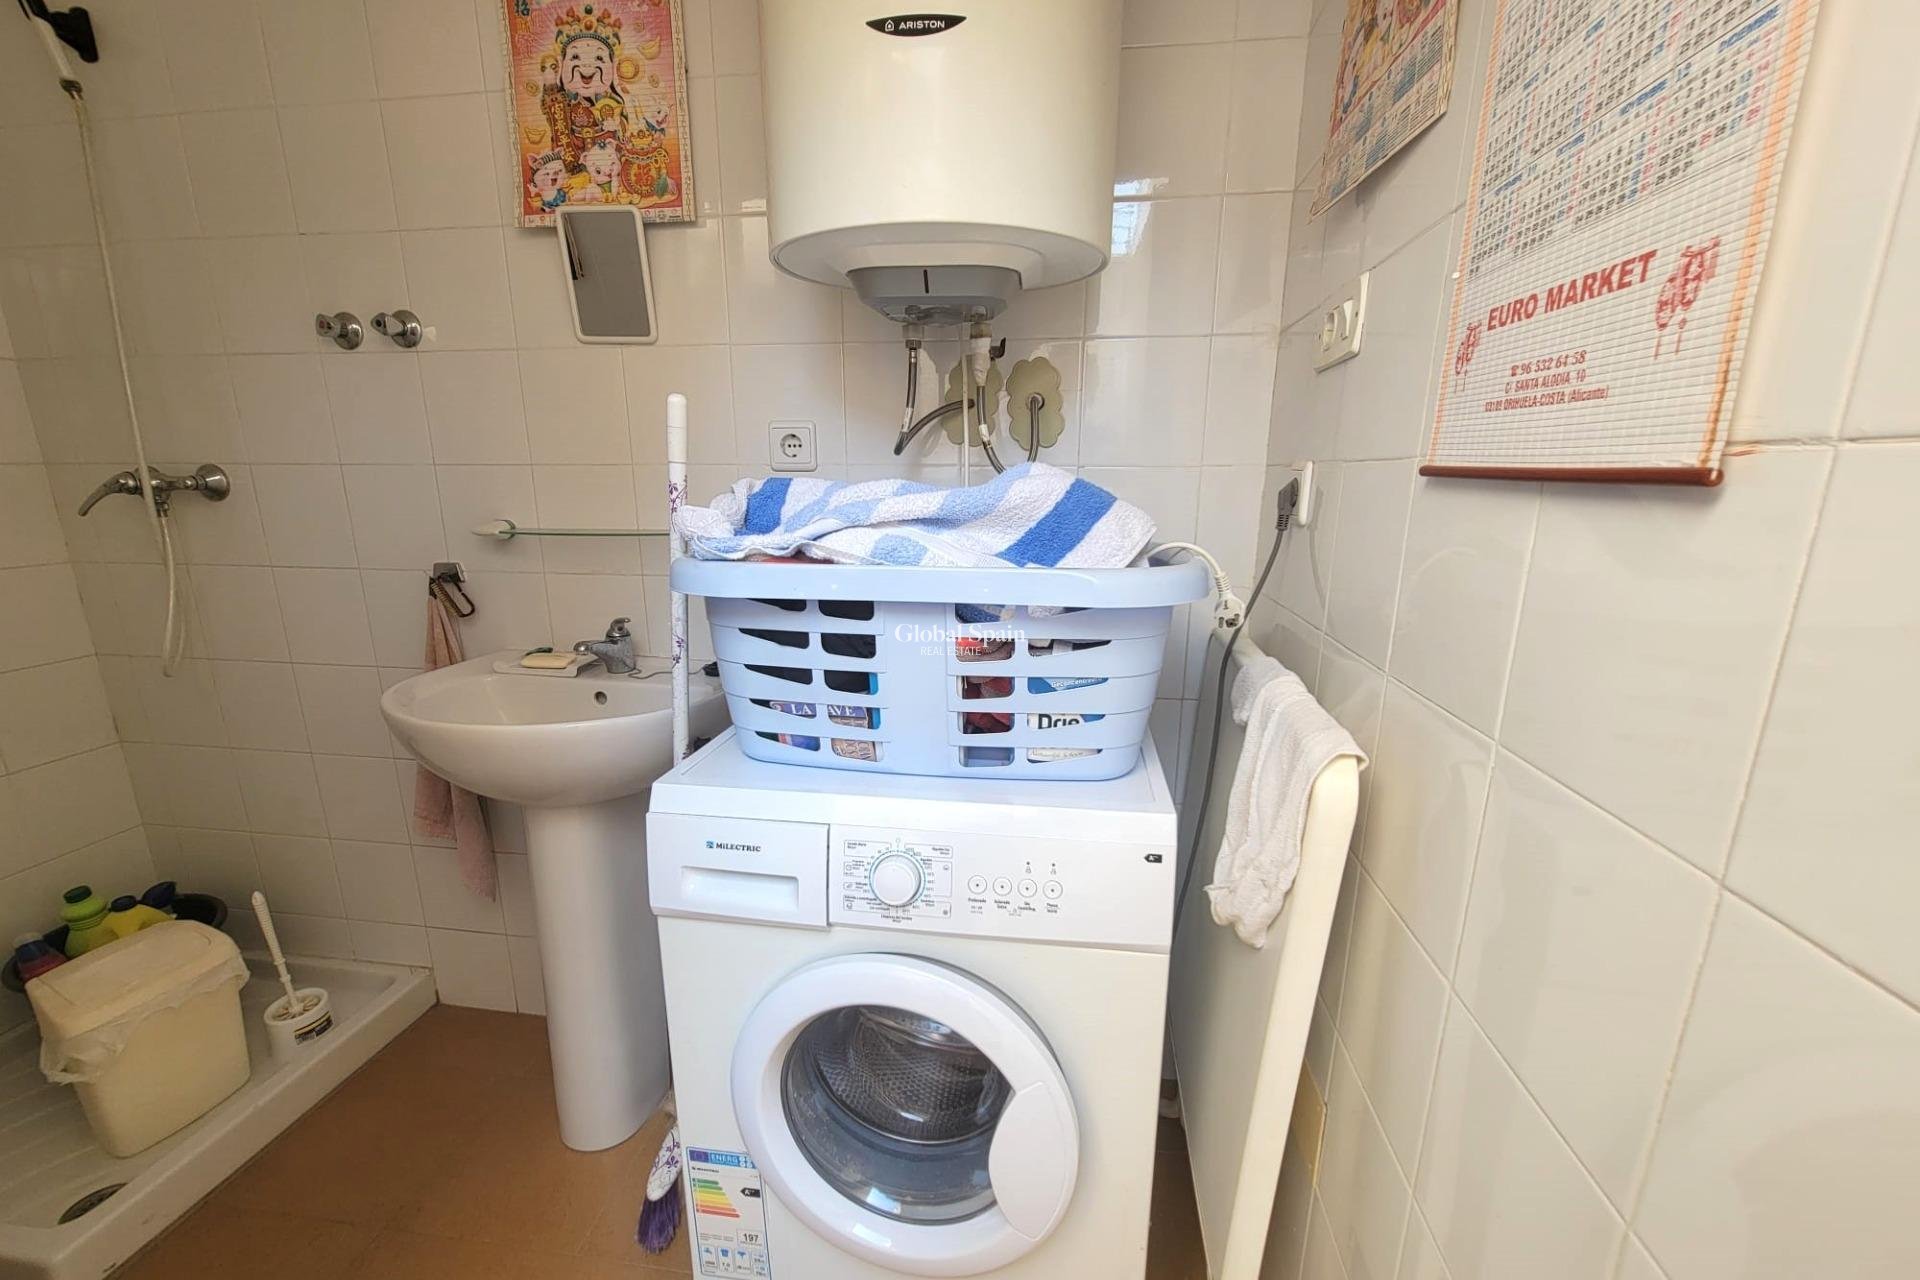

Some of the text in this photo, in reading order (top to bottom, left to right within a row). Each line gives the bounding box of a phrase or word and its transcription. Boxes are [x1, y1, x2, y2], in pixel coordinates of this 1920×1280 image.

[898, 20, 945, 30] ARISTON
[1487, 249, 1658, 331] EURO MARKET
[1520, 362, 1532, 376] 96
[1534, 358, 1553, 373] 532
[1514, 378, 1539, 393] SANTA
[1568, 384, 1610, 404] (Alicante)
[791, 703, 812, 715] LA
[743, 1233, 760, 1243] 197
